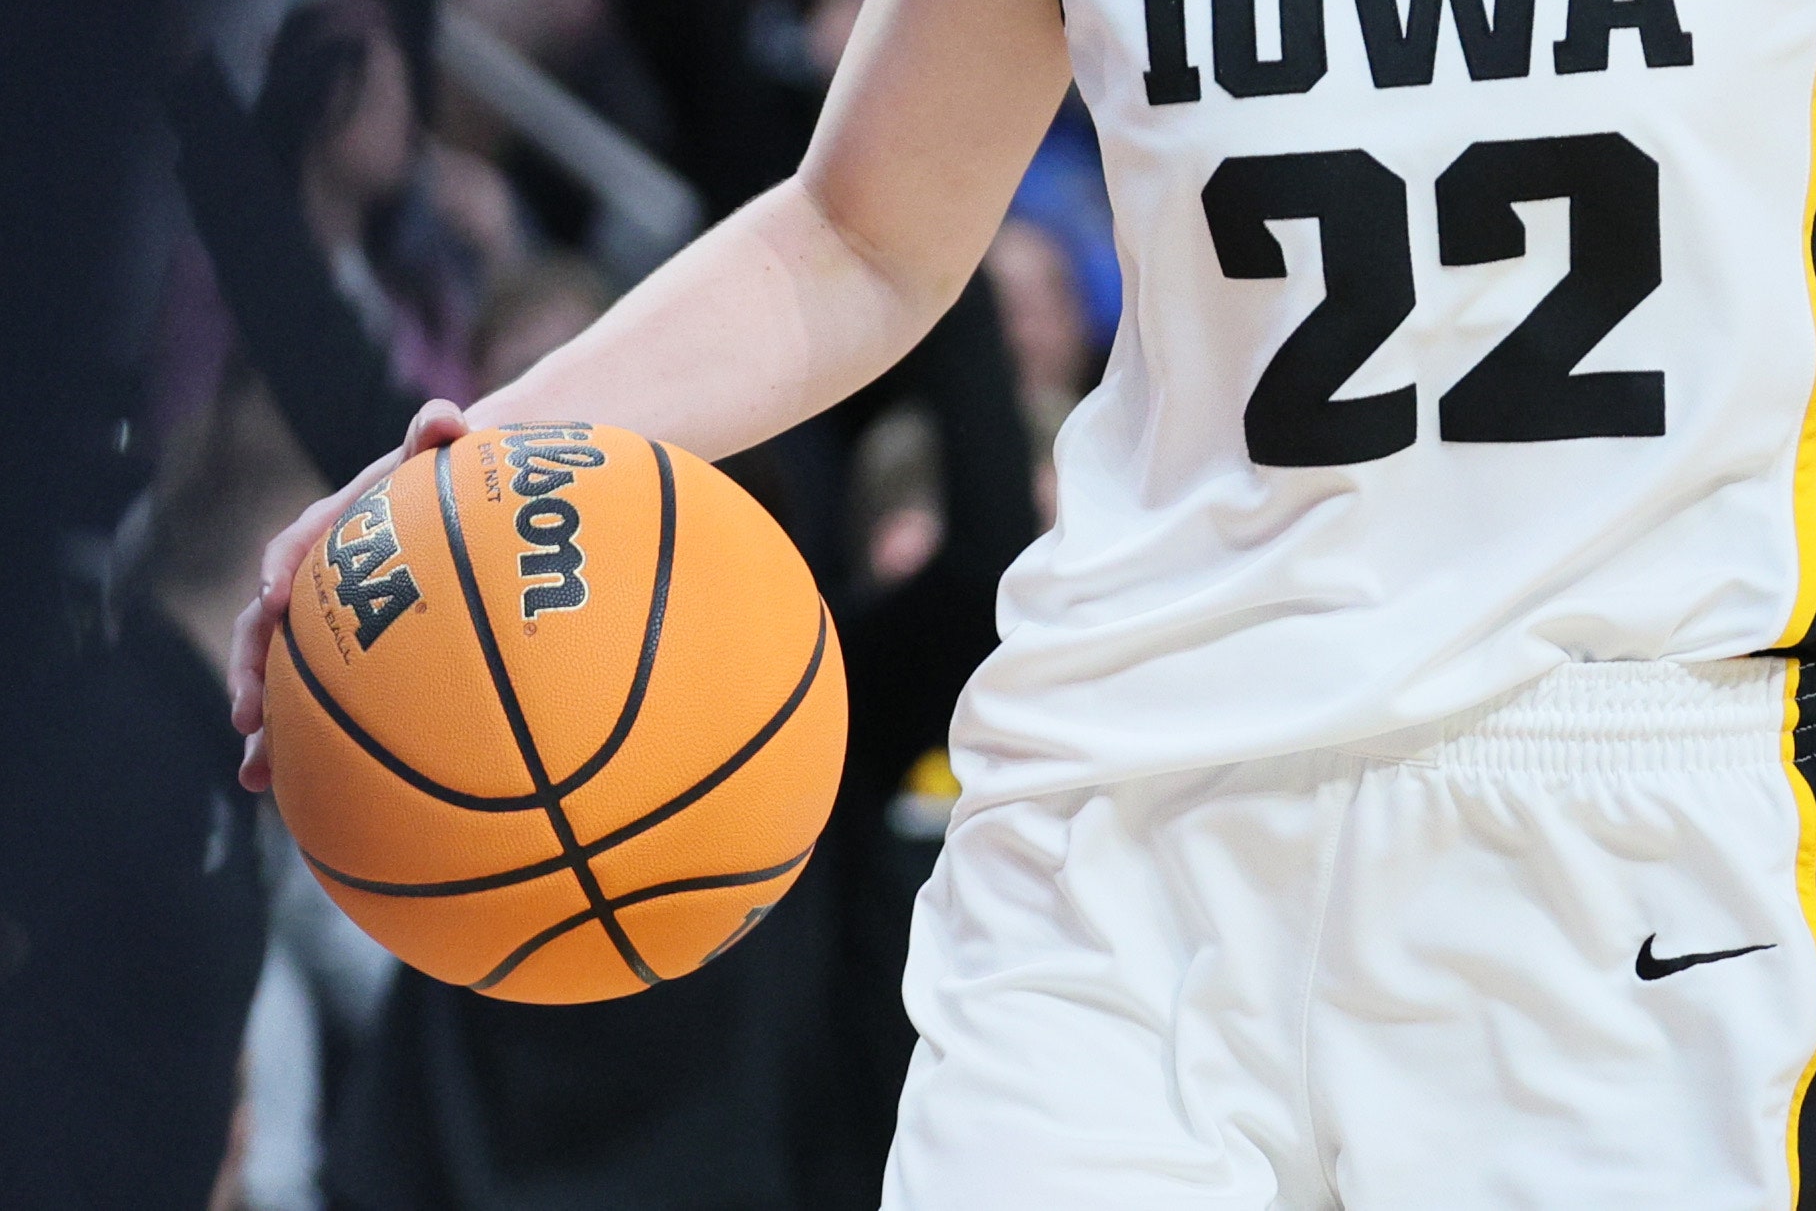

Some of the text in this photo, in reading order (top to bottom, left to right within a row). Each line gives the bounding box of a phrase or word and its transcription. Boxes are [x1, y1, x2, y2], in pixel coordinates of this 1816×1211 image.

[1201, 131, 1666, 467] 22
[485, 469, 501, 503] NXT
[325, 611, 350, 666] BALL
